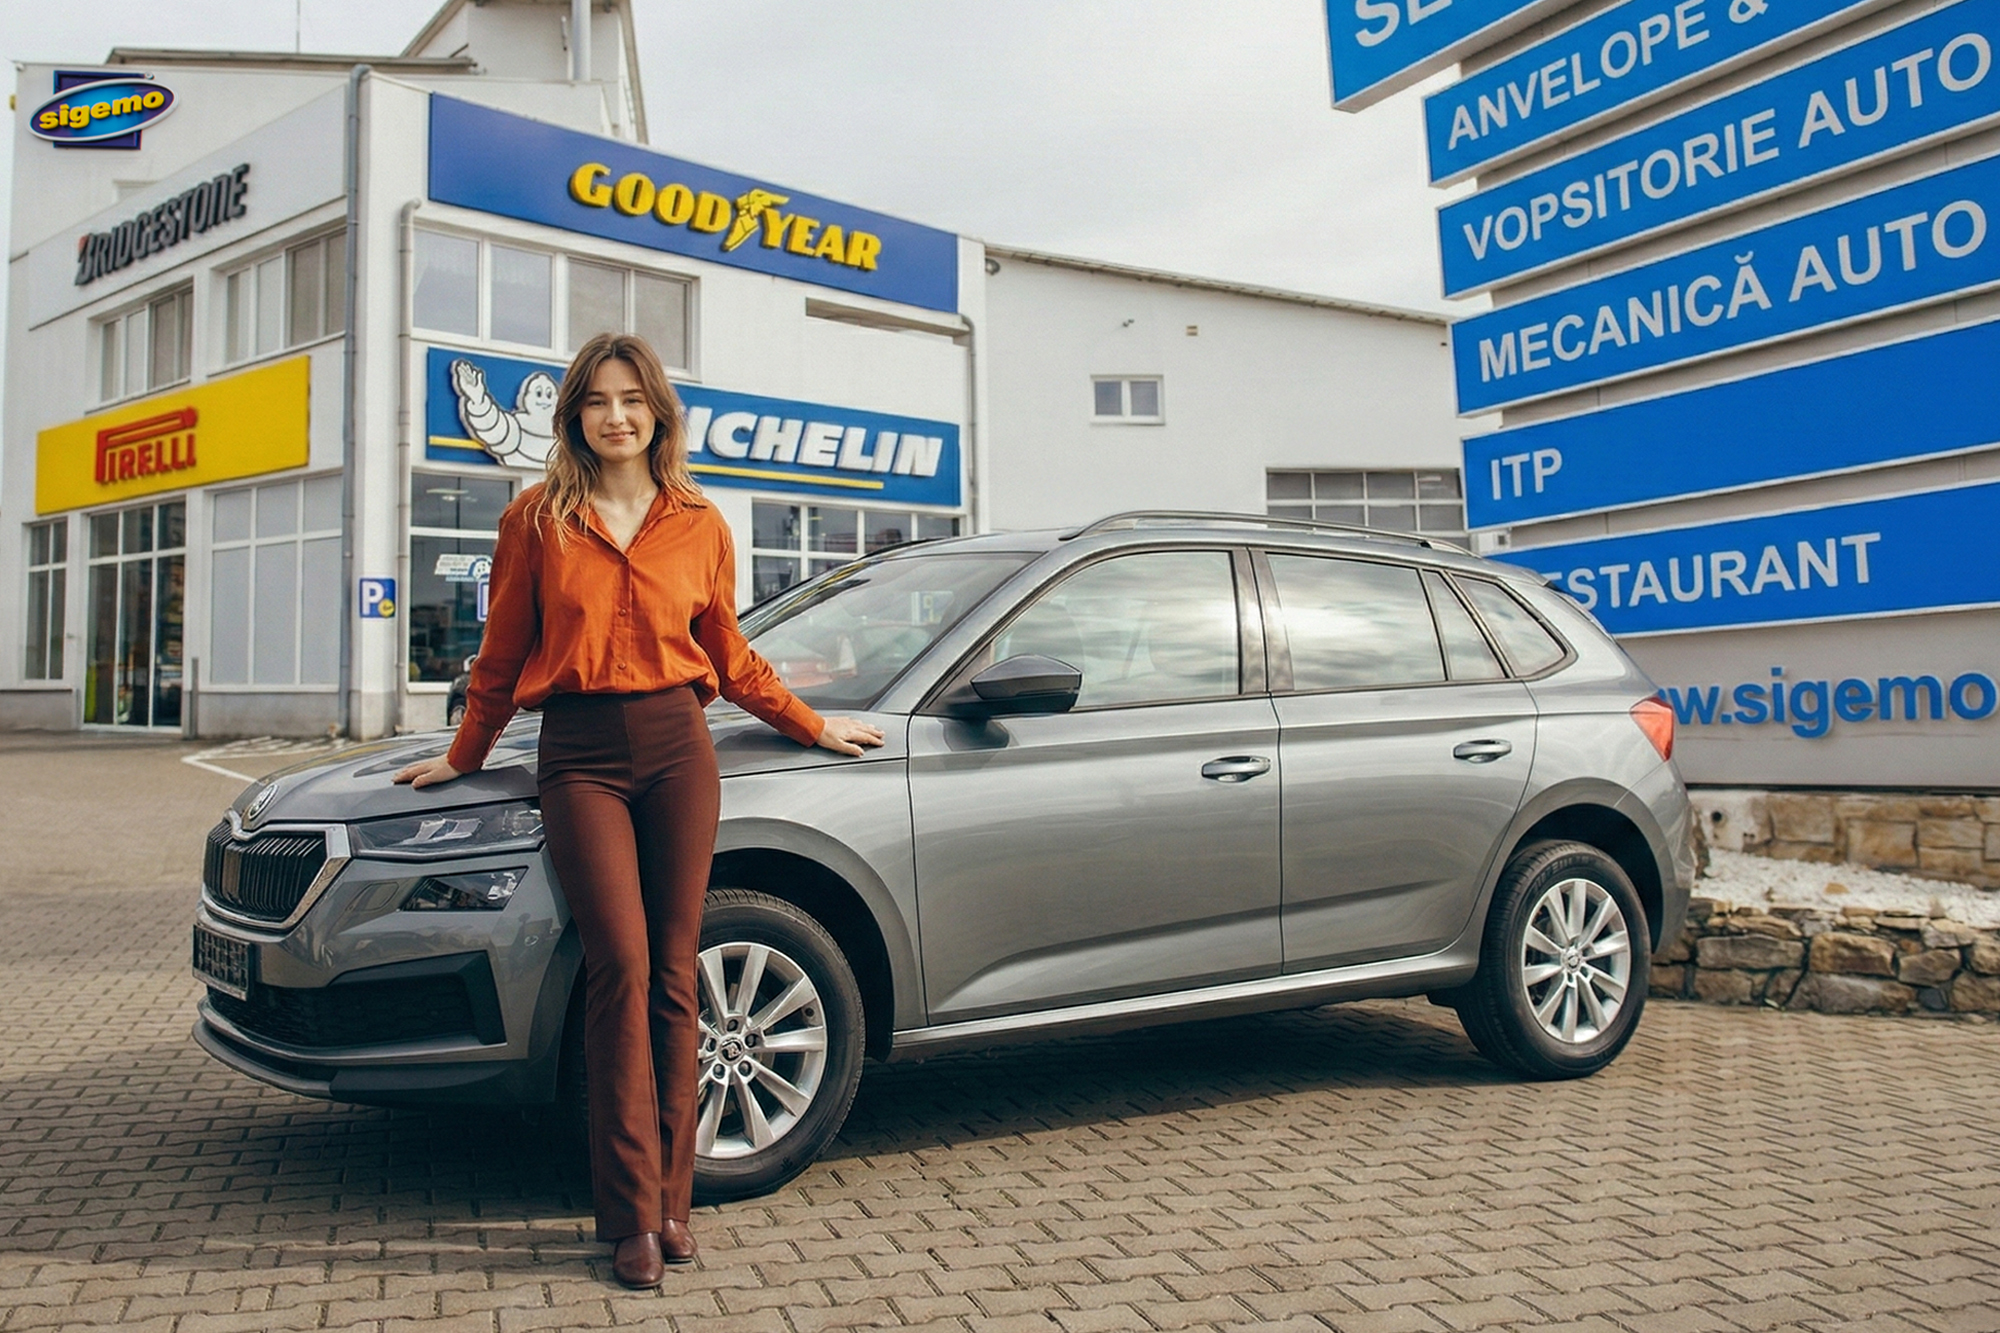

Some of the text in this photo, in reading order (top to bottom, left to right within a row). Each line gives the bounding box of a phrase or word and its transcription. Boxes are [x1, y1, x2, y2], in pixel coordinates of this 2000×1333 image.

[38, 90, 165, 130] sigemo
[1447, 1, 1710, 150] ANVELOPE
[1463, 32, 1992, 261] VOPSITORIE AUTO
[74, 162, 251, 286] BRIDGESTONE
[569, 162, 883, 272] GOODYEAR
[1479, 199, 1988, 383] MECANICĂ AUTO
[94, 406, 198, 485] PIRELLI
[685, 405, 943, 478] ICHELIN
[1490, 447, 1564, 501] ITP
[362, 581, 384, 616] P
[1541, 532, 1882, 611] STAURANT
[1658, 666, 1998, 740] w.sigemo
